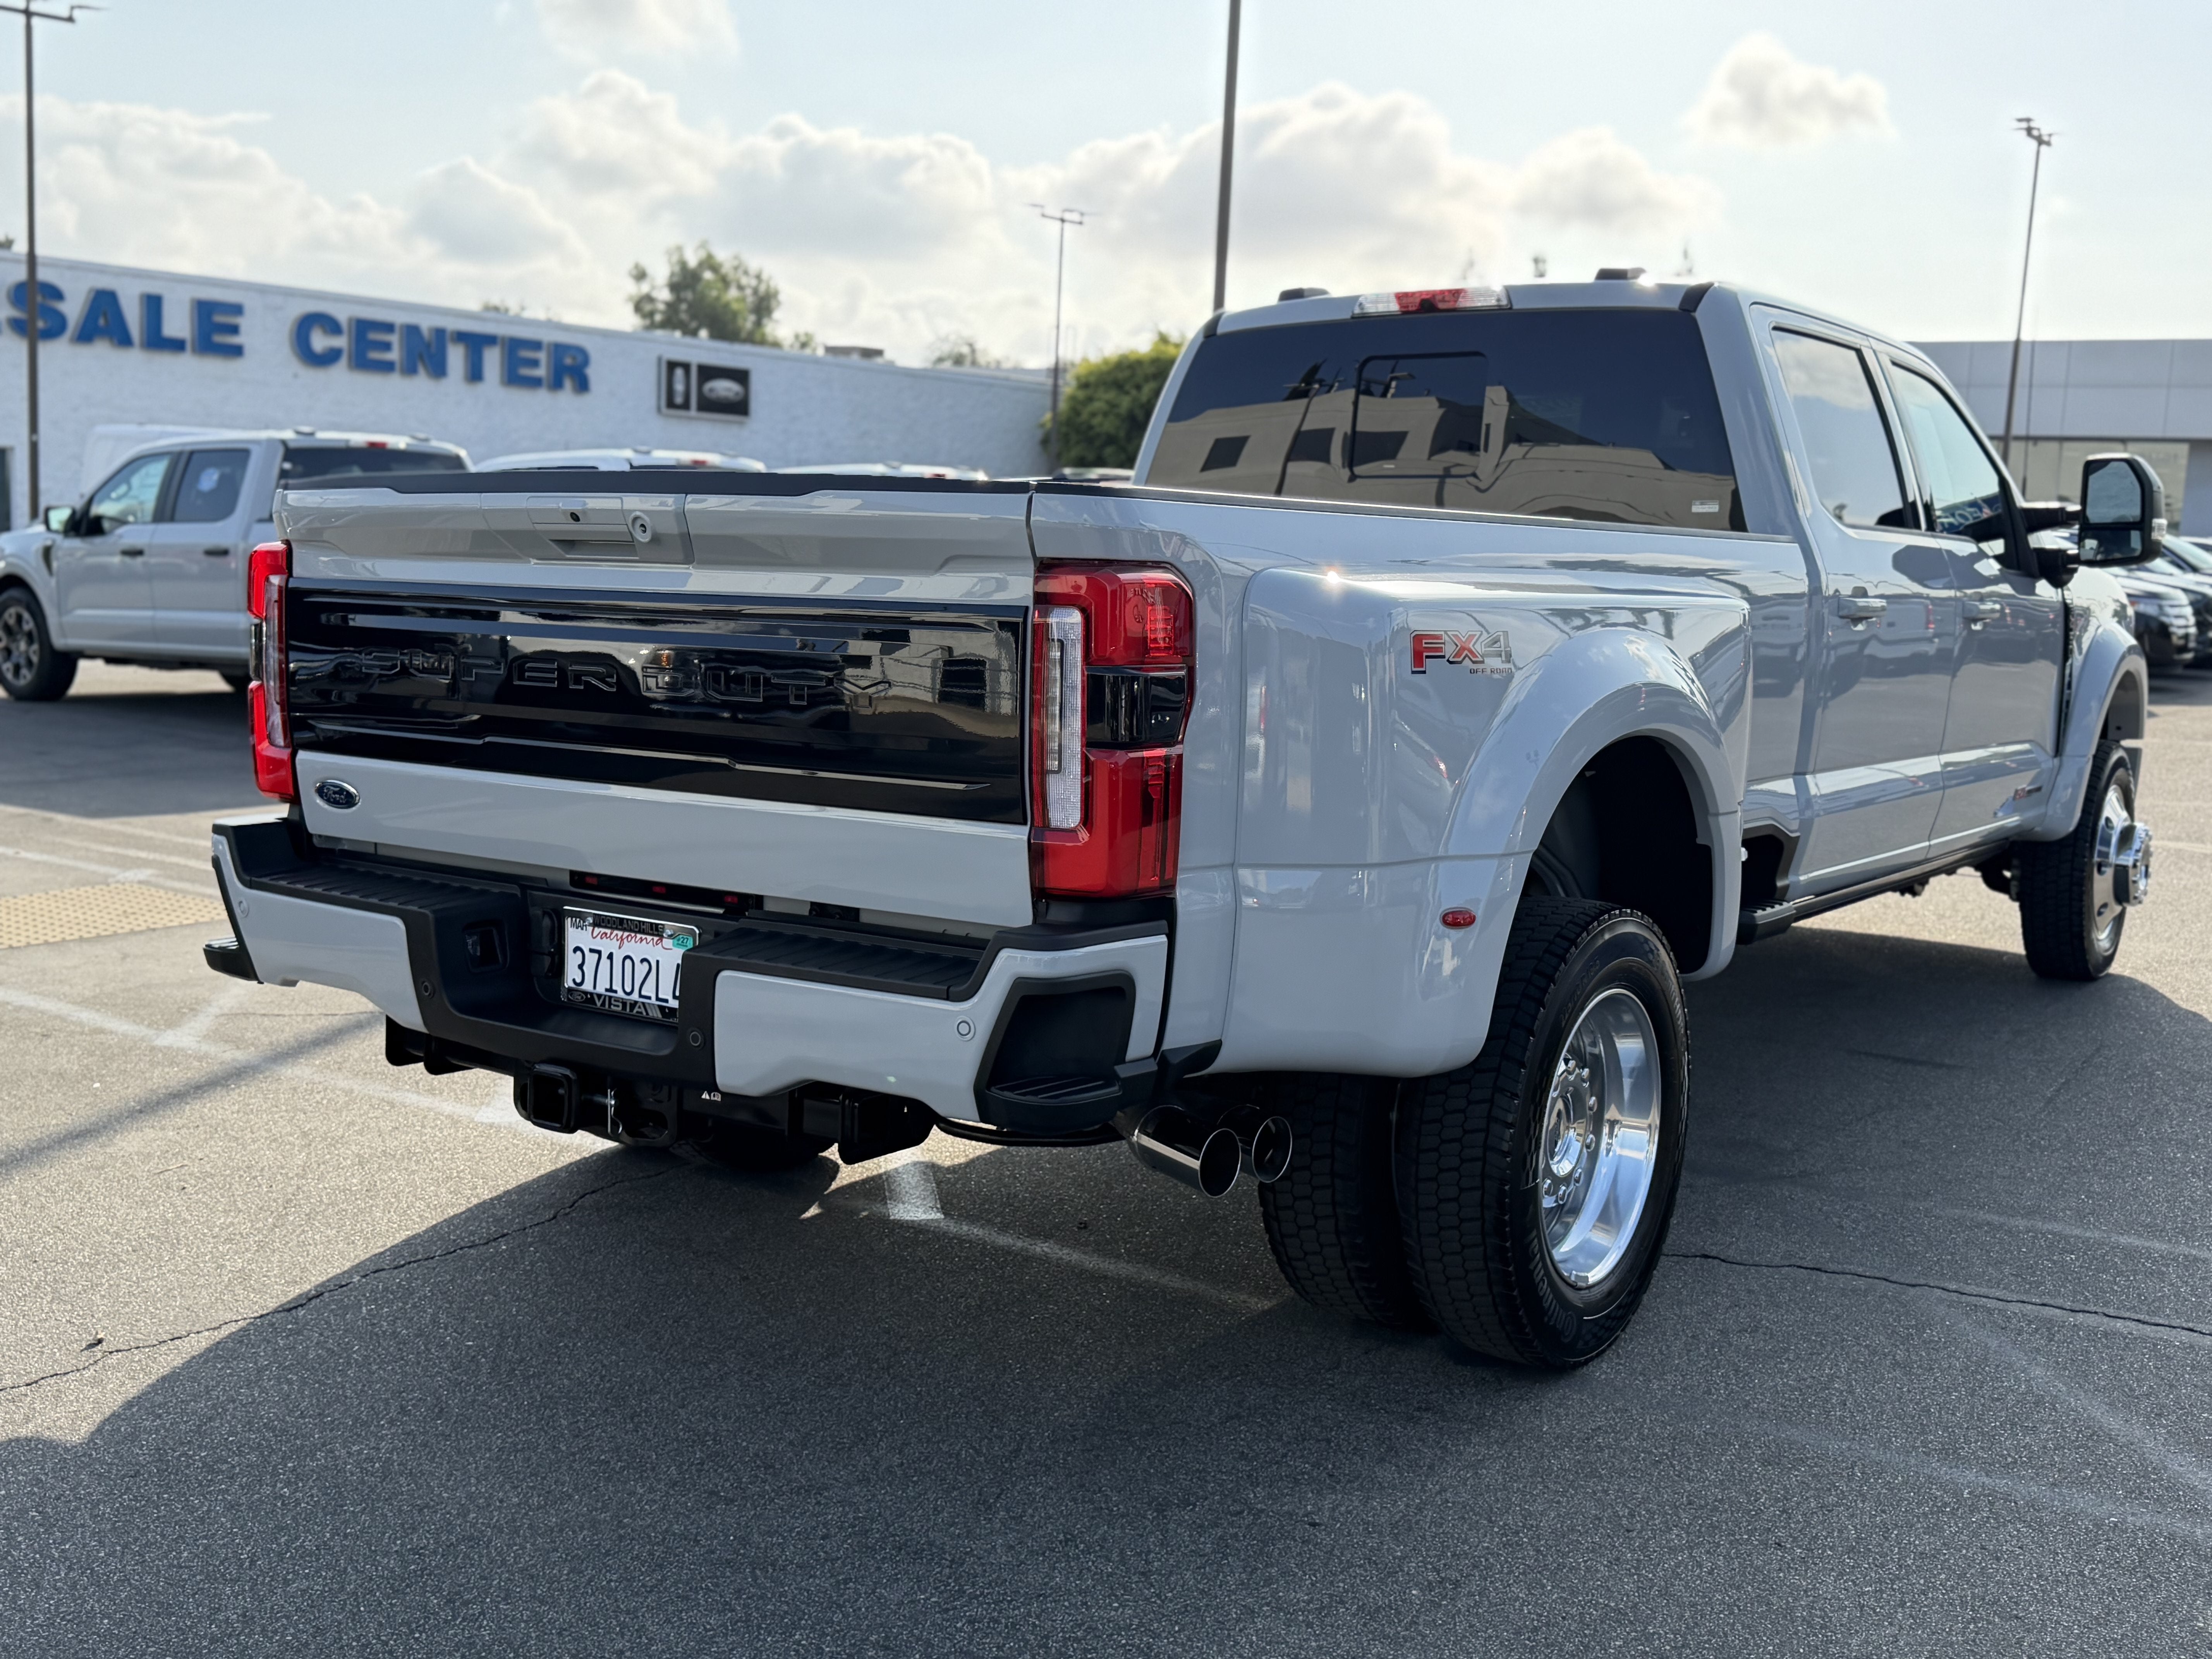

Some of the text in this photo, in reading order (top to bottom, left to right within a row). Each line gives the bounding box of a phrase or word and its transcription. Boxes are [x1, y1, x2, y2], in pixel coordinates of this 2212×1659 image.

[0, 280, 591, 394] SALE CENTER
[1410, 630, 1511, 674] FX4
[361, 647, 891, 709] SUPER DUTY
[323, 785, 347, 803] Ford
[593, 914, 663, 936] WOODLAND HILLS
[591, 926, 673, 950] California
[593, 993, 646, 1015] VISTA
